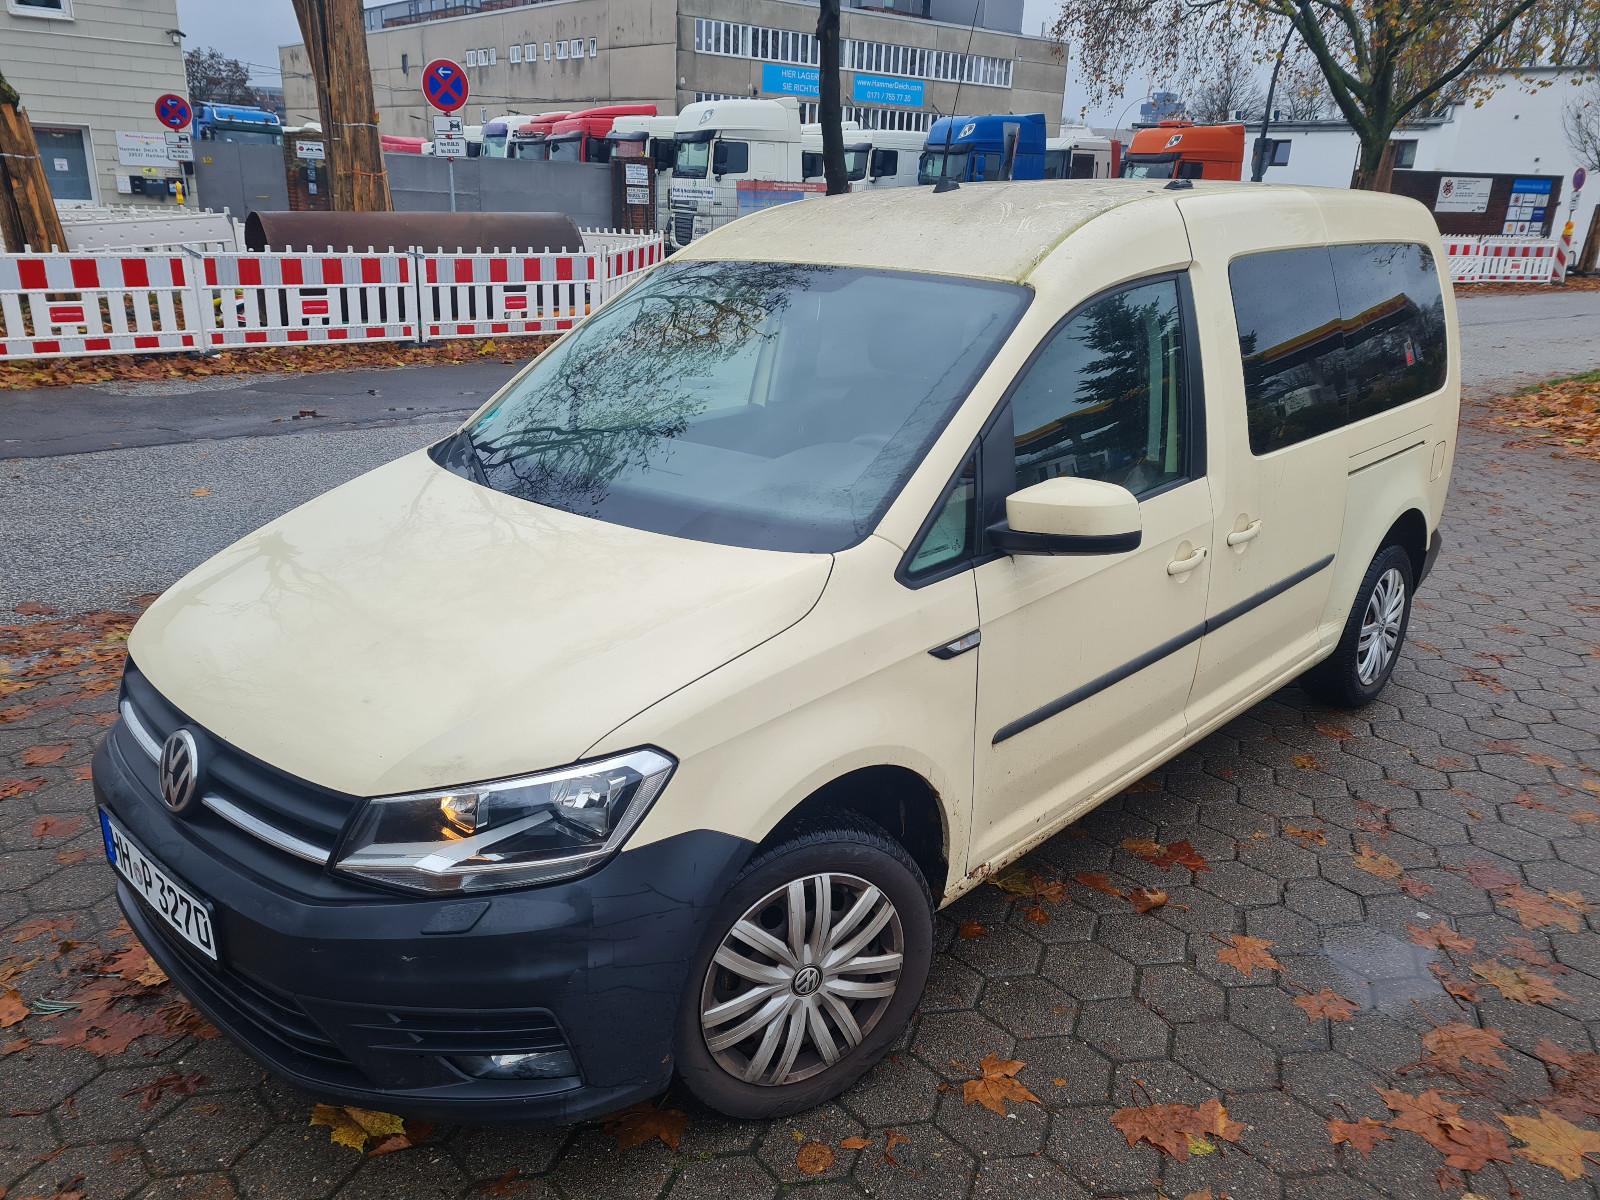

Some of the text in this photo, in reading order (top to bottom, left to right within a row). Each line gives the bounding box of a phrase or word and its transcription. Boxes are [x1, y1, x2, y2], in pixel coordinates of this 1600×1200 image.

[781, 69, 796, 79] HIER
[782, 82, 793, 91] SIE
[856, 79, 922, 92] www.HammerDeich.com
[866, 90, 880, 99] 0171
[140, 857, 152, 895] P
[155, 872, 212, 950] 3270
